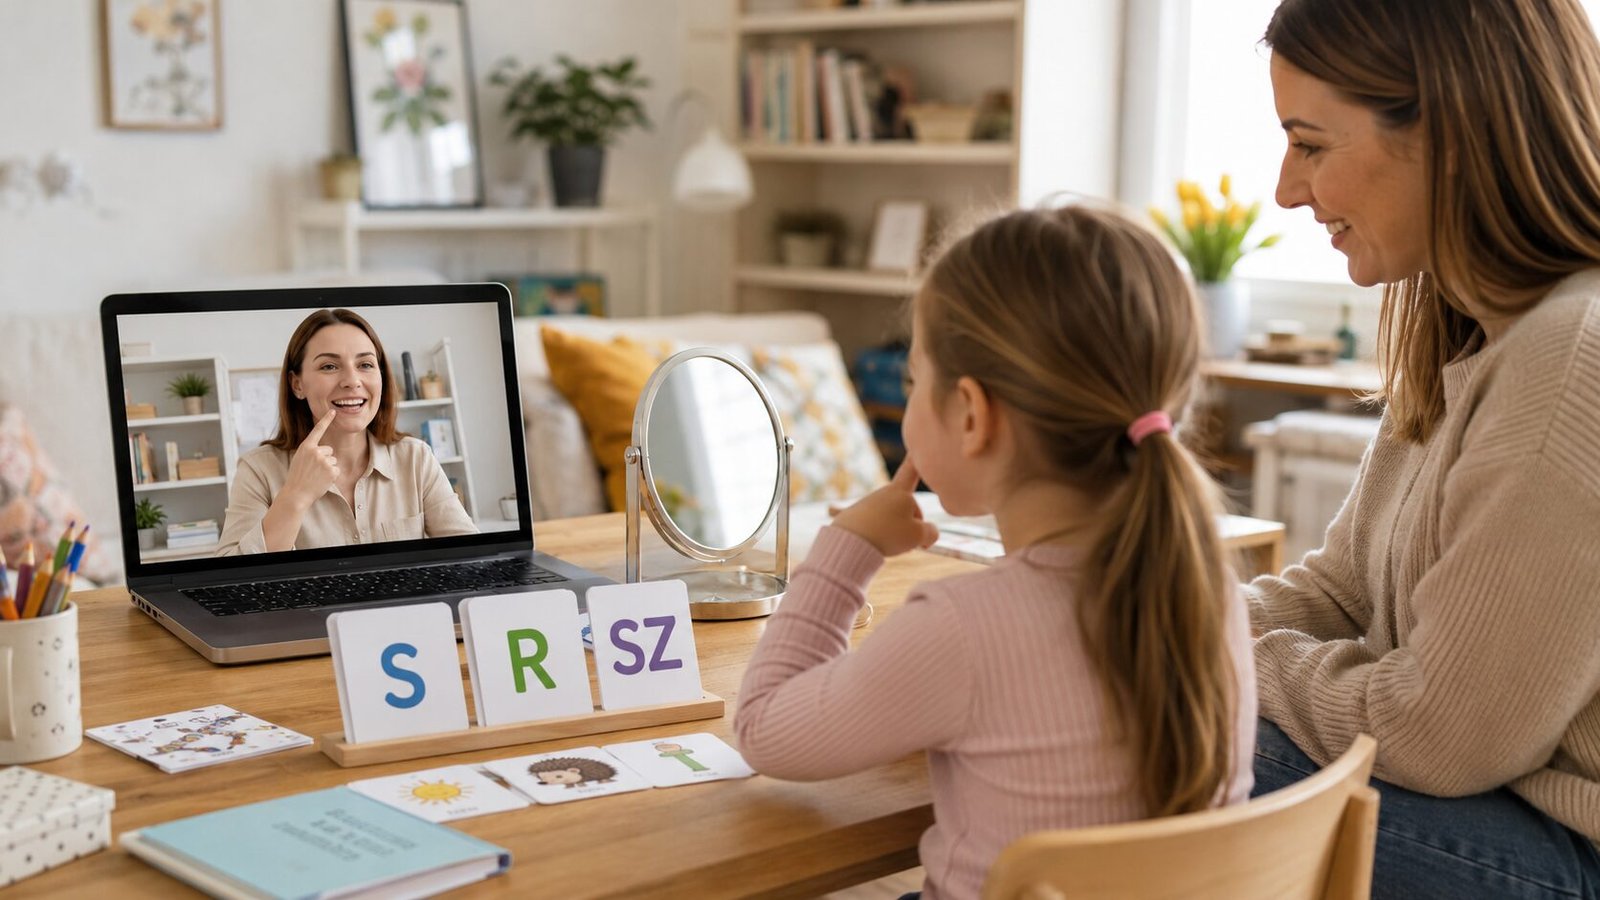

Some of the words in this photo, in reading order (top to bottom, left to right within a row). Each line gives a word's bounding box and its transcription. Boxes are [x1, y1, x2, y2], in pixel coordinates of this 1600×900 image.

[380, 642, 426, 709] S
[507, 628, 557, 693] R
[609, 615, 683, 675] SZ
